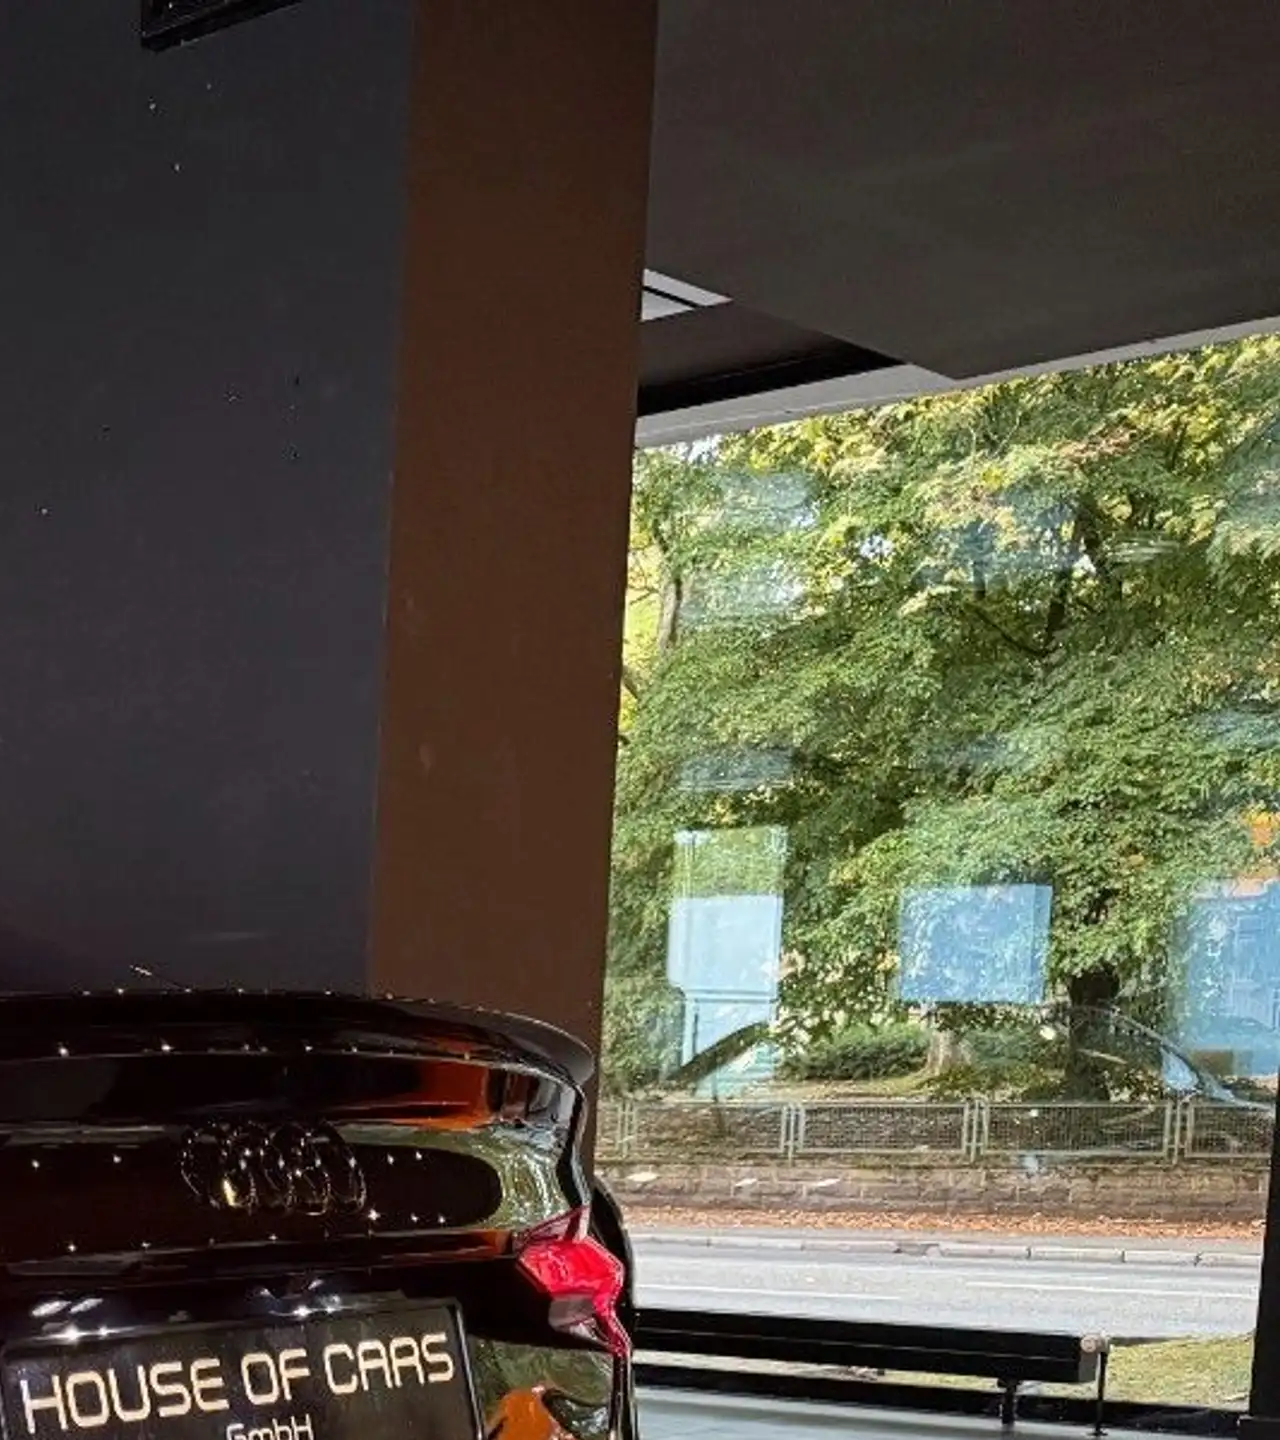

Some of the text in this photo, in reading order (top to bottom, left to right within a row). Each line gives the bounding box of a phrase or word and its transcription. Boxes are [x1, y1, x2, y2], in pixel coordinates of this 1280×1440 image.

[19, 1332, 455, 1434] HOUSE OF CARS
